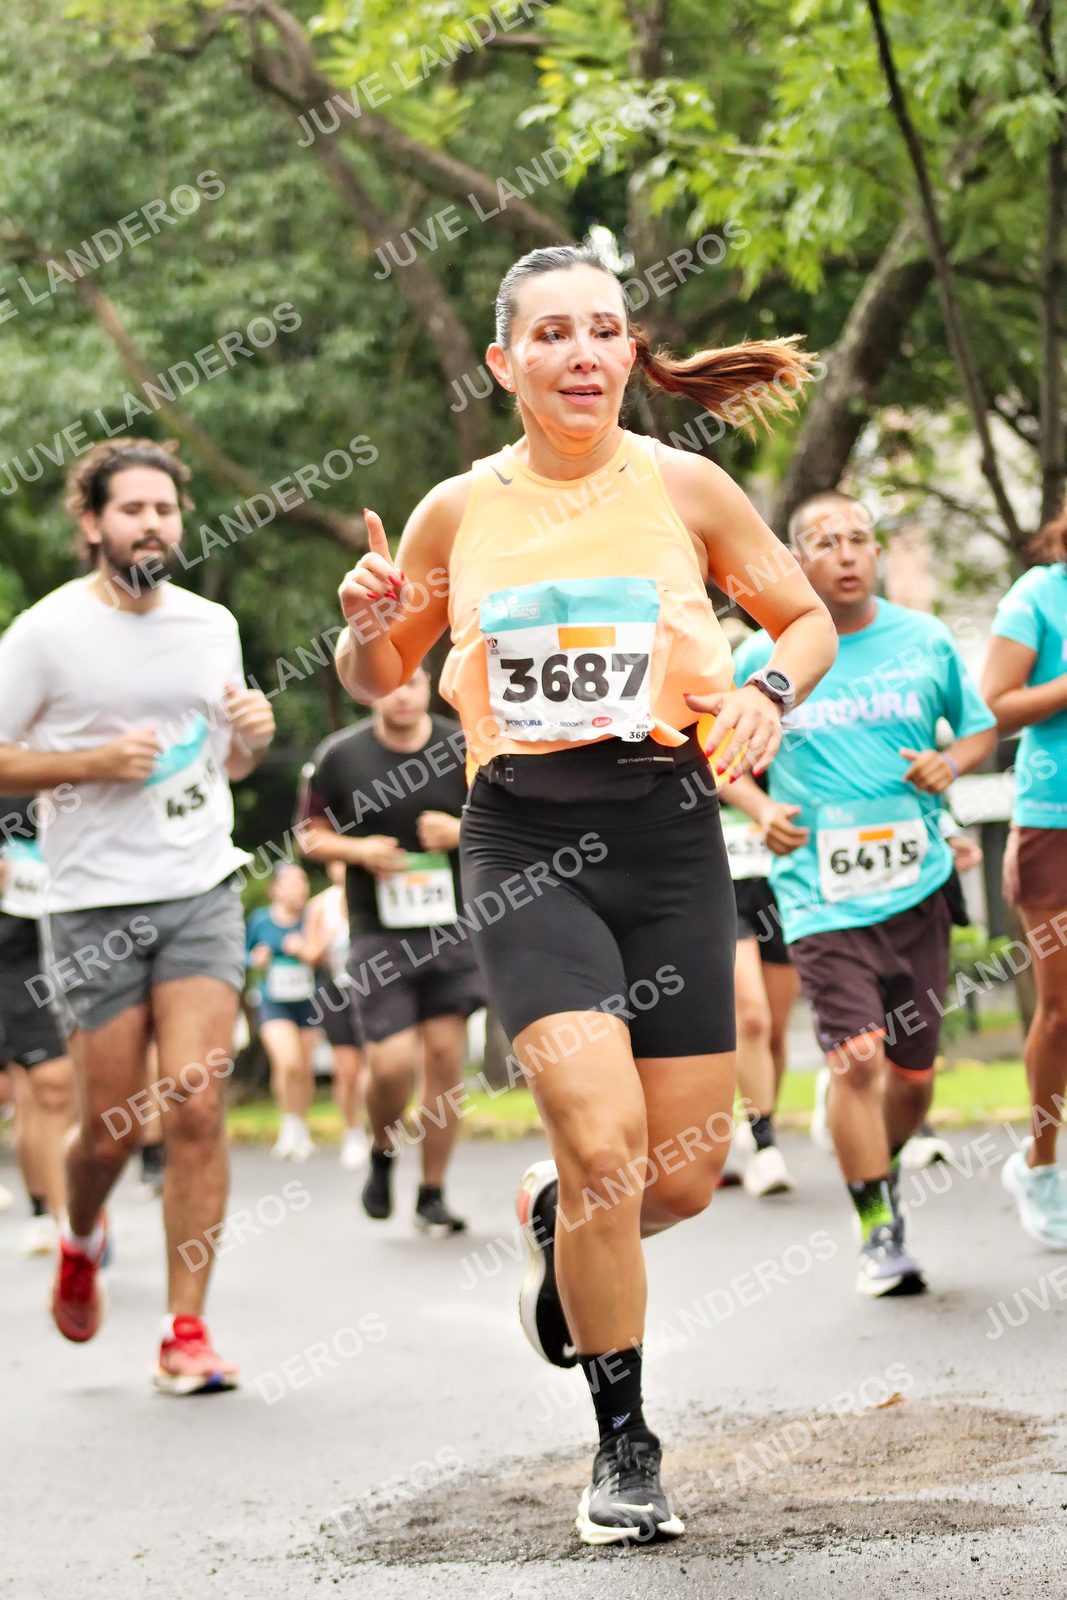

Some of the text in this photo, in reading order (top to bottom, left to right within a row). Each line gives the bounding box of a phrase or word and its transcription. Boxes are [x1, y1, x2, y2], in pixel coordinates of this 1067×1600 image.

[500, 653, 649, 703] 3687
[786, 690, 922, 729] ERDURA
[829, 839, 920, 875] 6415
